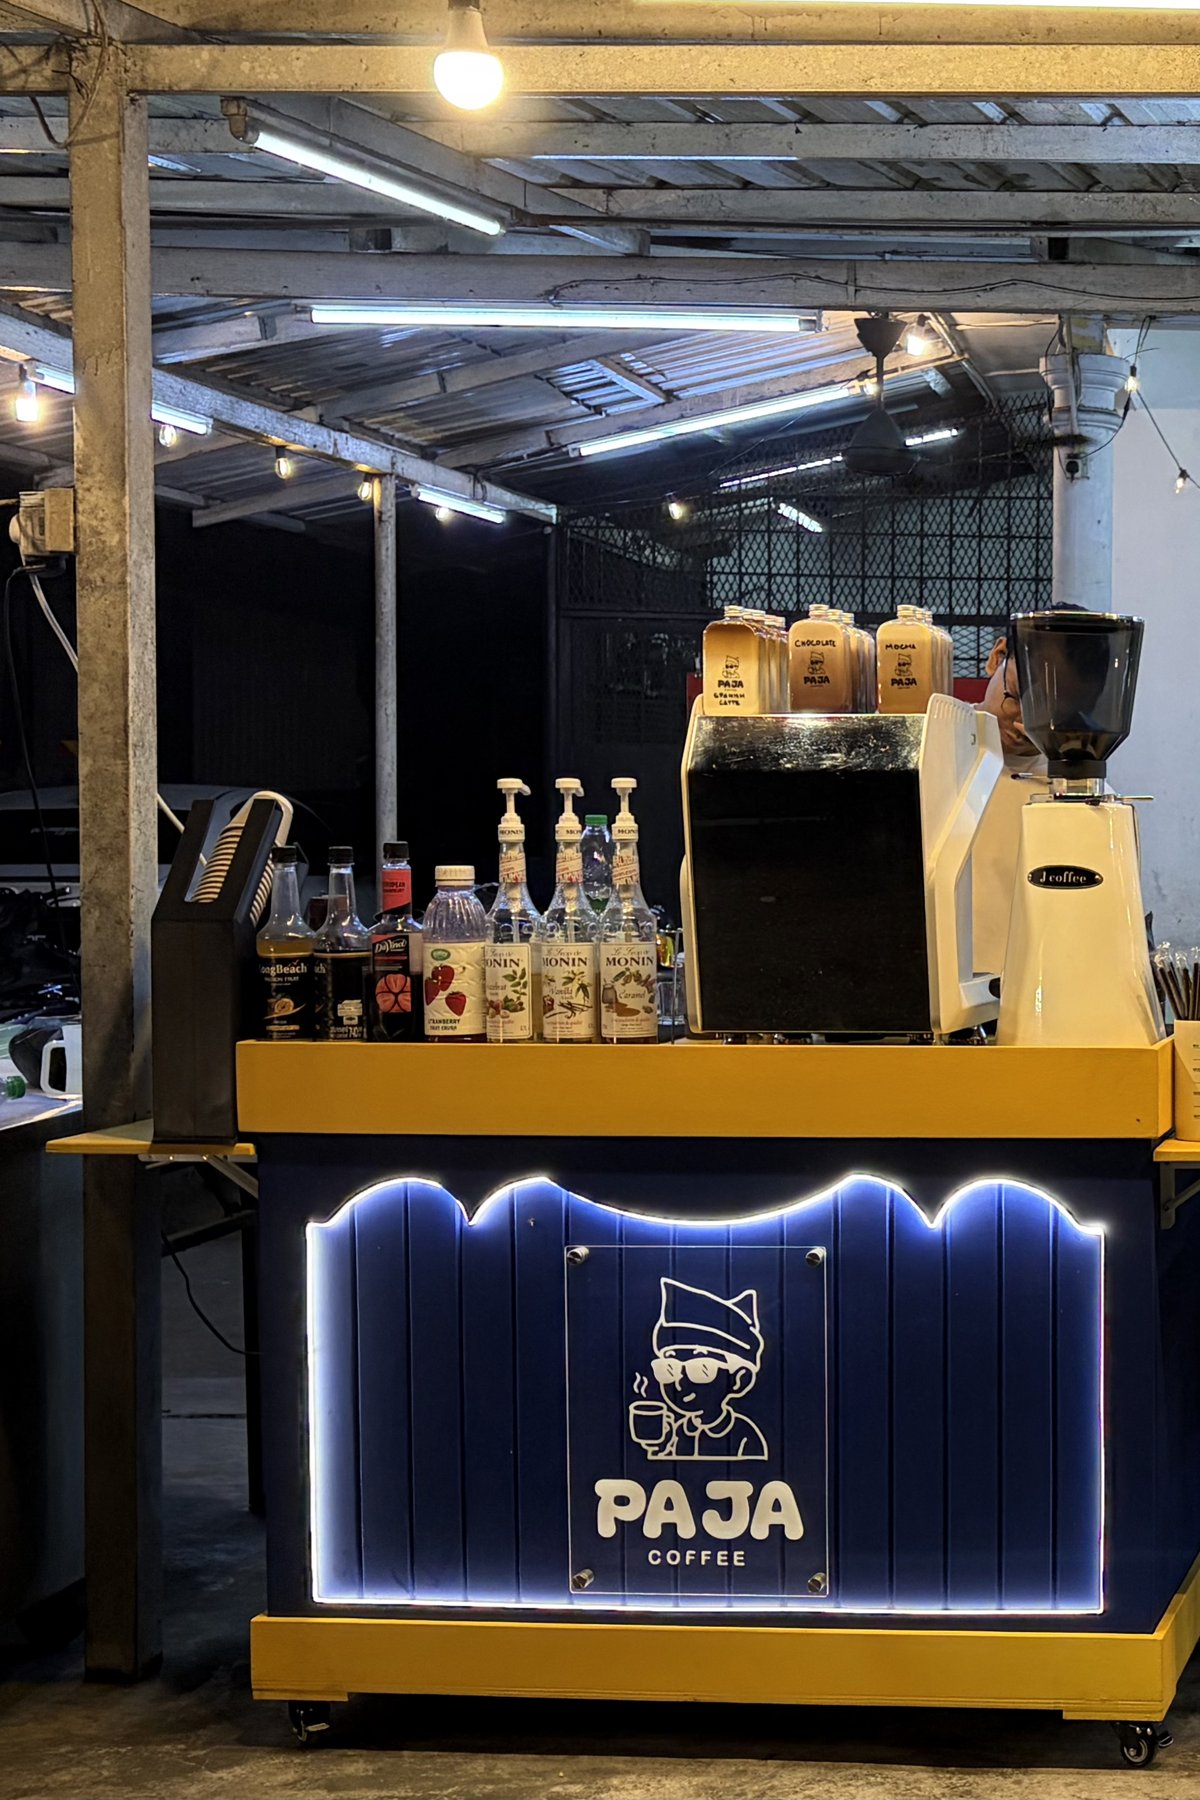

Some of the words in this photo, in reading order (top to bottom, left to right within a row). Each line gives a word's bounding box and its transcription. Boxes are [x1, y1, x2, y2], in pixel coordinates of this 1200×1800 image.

[794, 639, 836, 648] CHOCOLATE
[717, 679, 744, 689] PAJA
[803, 675, 831, 685] PAJA
[890, 677, 918, 687] PAJA
[1039, 871, 1047, 883] J
[1049, 871, 1087, 883] coffee
[486, 958, 520, 968] ONIN
[606, 957, 654, 967] MONIN
[594, 1478, 804, 1541] PAJA
[648, 1550, 746, 1567] COFFEE
